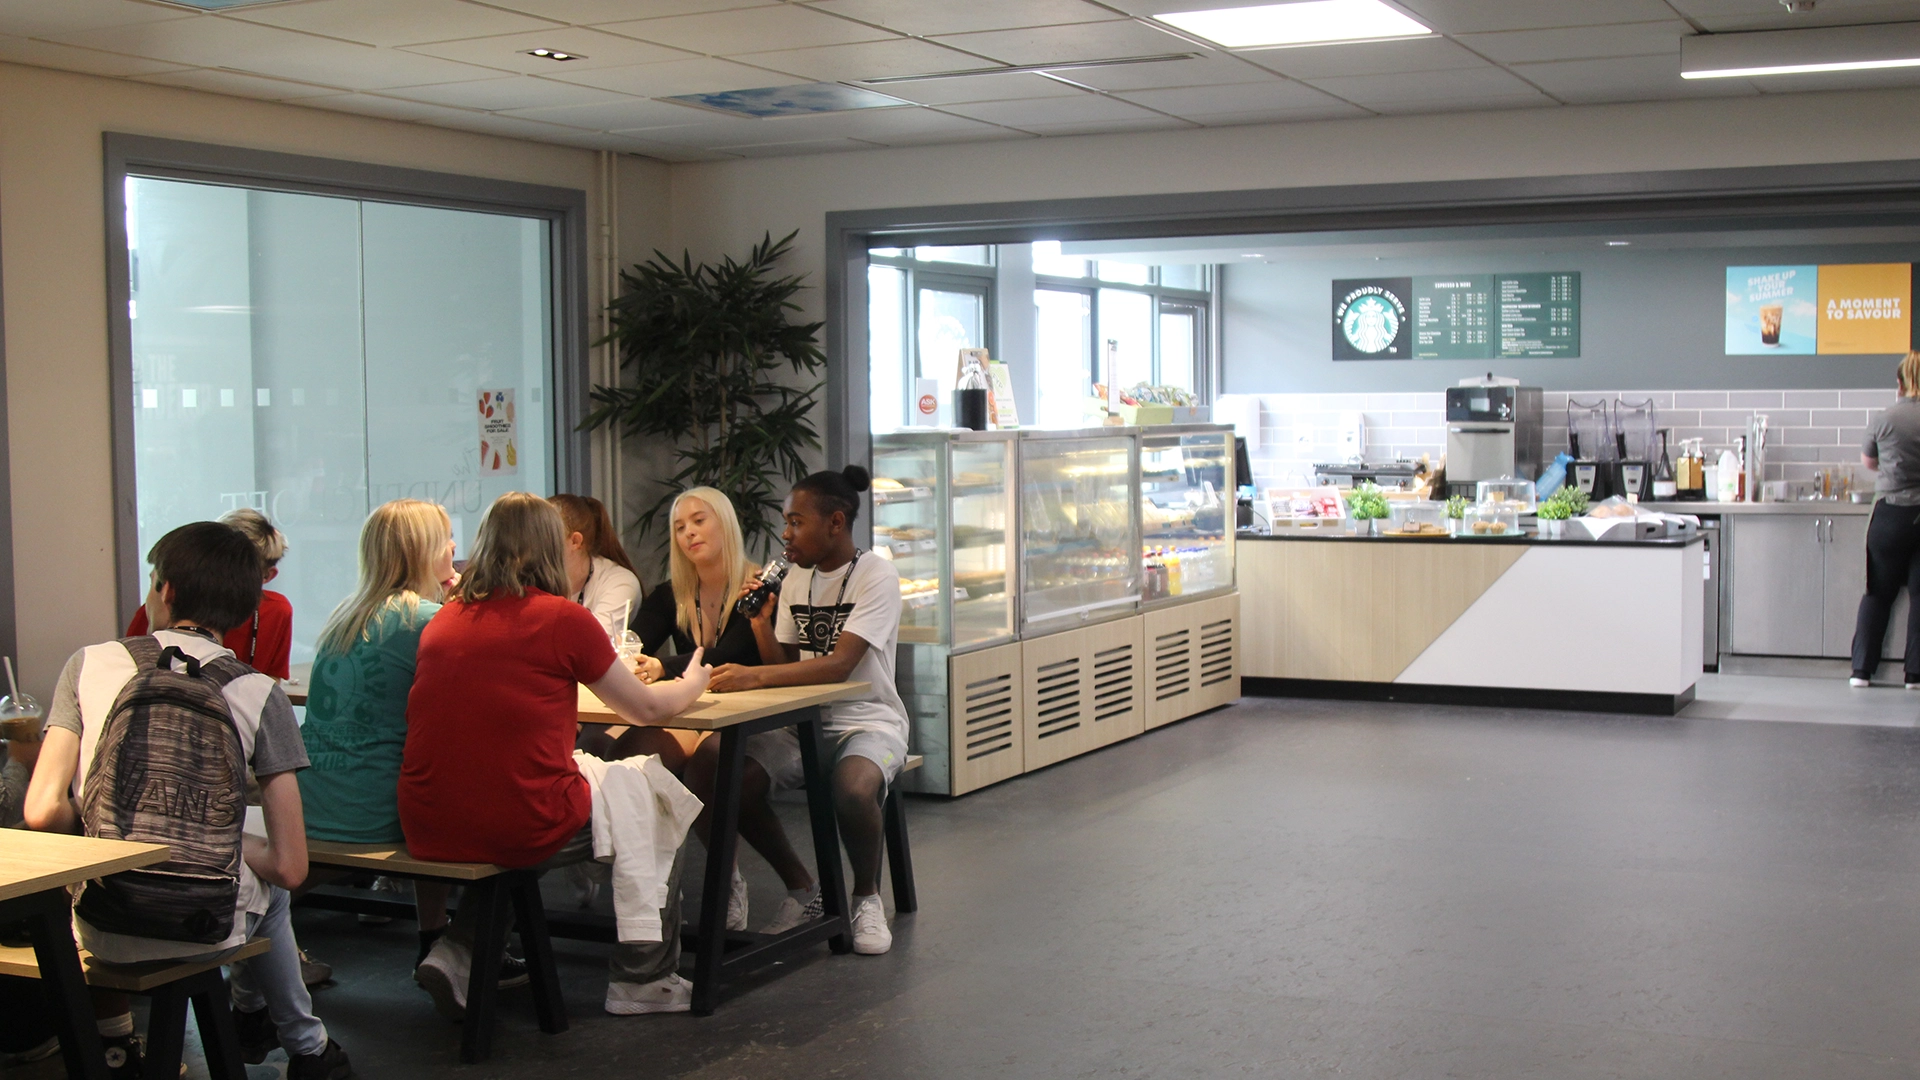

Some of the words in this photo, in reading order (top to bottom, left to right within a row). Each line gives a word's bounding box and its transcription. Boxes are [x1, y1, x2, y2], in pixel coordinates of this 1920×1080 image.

[1747, 273, 1781, 287] SHAKE
[1782, 270, 1796, 279] UP
[1757, 280, 1786, 292] YOUR
[1336, 302, 1348, 317] WE
[1345, 286, 1384, 304] PROUDLY
[1384, 290, 1406, 314] SERVE
[1749, 287, 1794, 303] SUMMER
[1827, 299, 1837, 310] A
[1839, 297, 1901, 309] MOMENT
[1826, 309, 1844, 320] TO
[1846, 309, 1901, 320] SAVOUR
[921, 398, 936, 406] ASK
[118, 760, 235, 828] VANS
